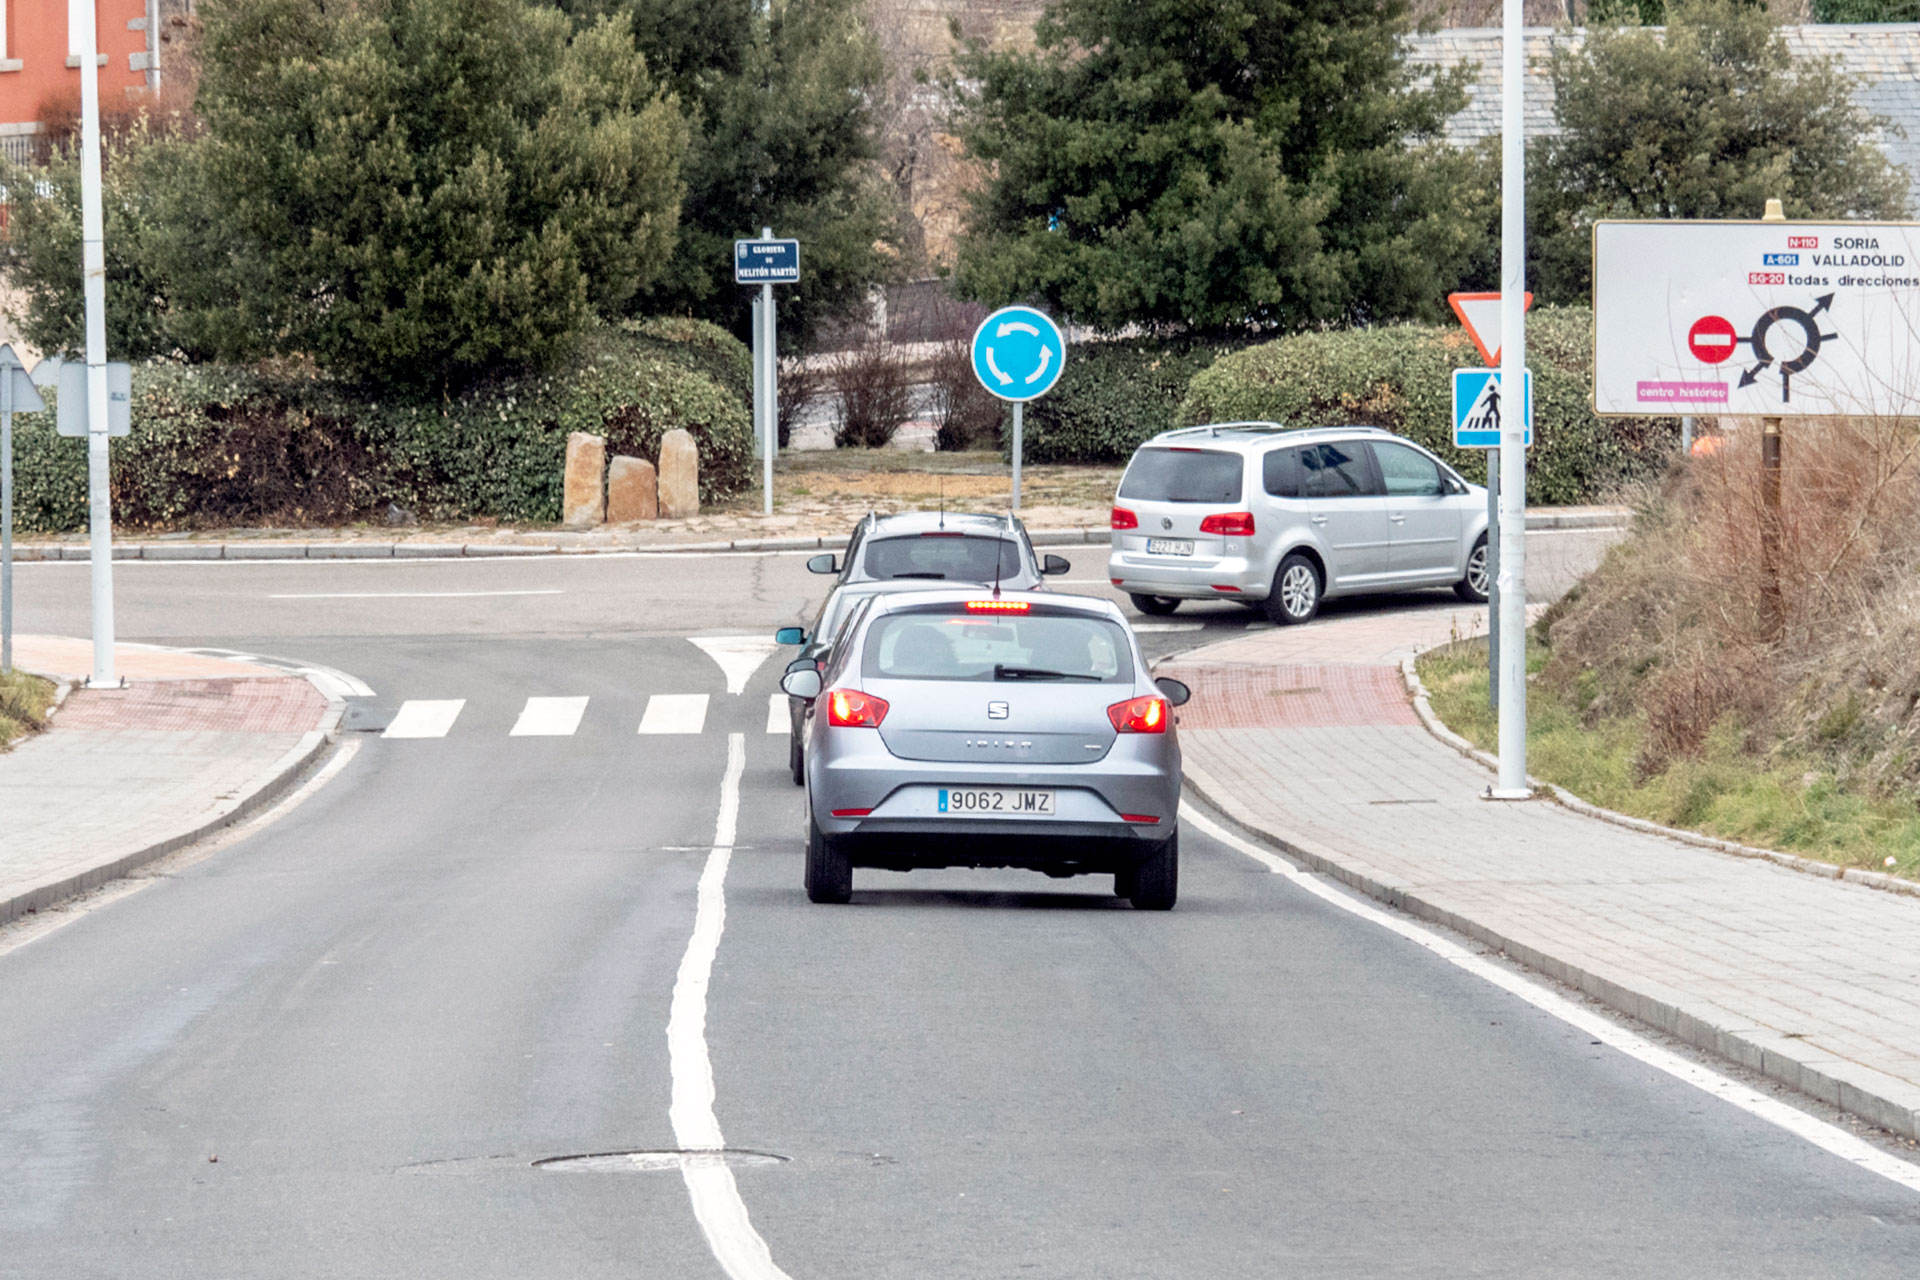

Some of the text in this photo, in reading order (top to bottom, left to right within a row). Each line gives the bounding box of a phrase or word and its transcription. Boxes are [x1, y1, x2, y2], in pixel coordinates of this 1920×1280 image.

[1789, 237, 1880, 249] N-110 SORIA
[752, 246, 786, 254] GLORIETA
[1766, 255, 1905, 267] A-601 VALLADOLID
[739, 264, 797, 277] MELITÓN MARTÍN
[1750, 274, 1920, 287] SG-20 todas direcciones
[1639, 387, 1726, 398] centro histórico
[952, 791, 1049, 811] 9062 JMZ
